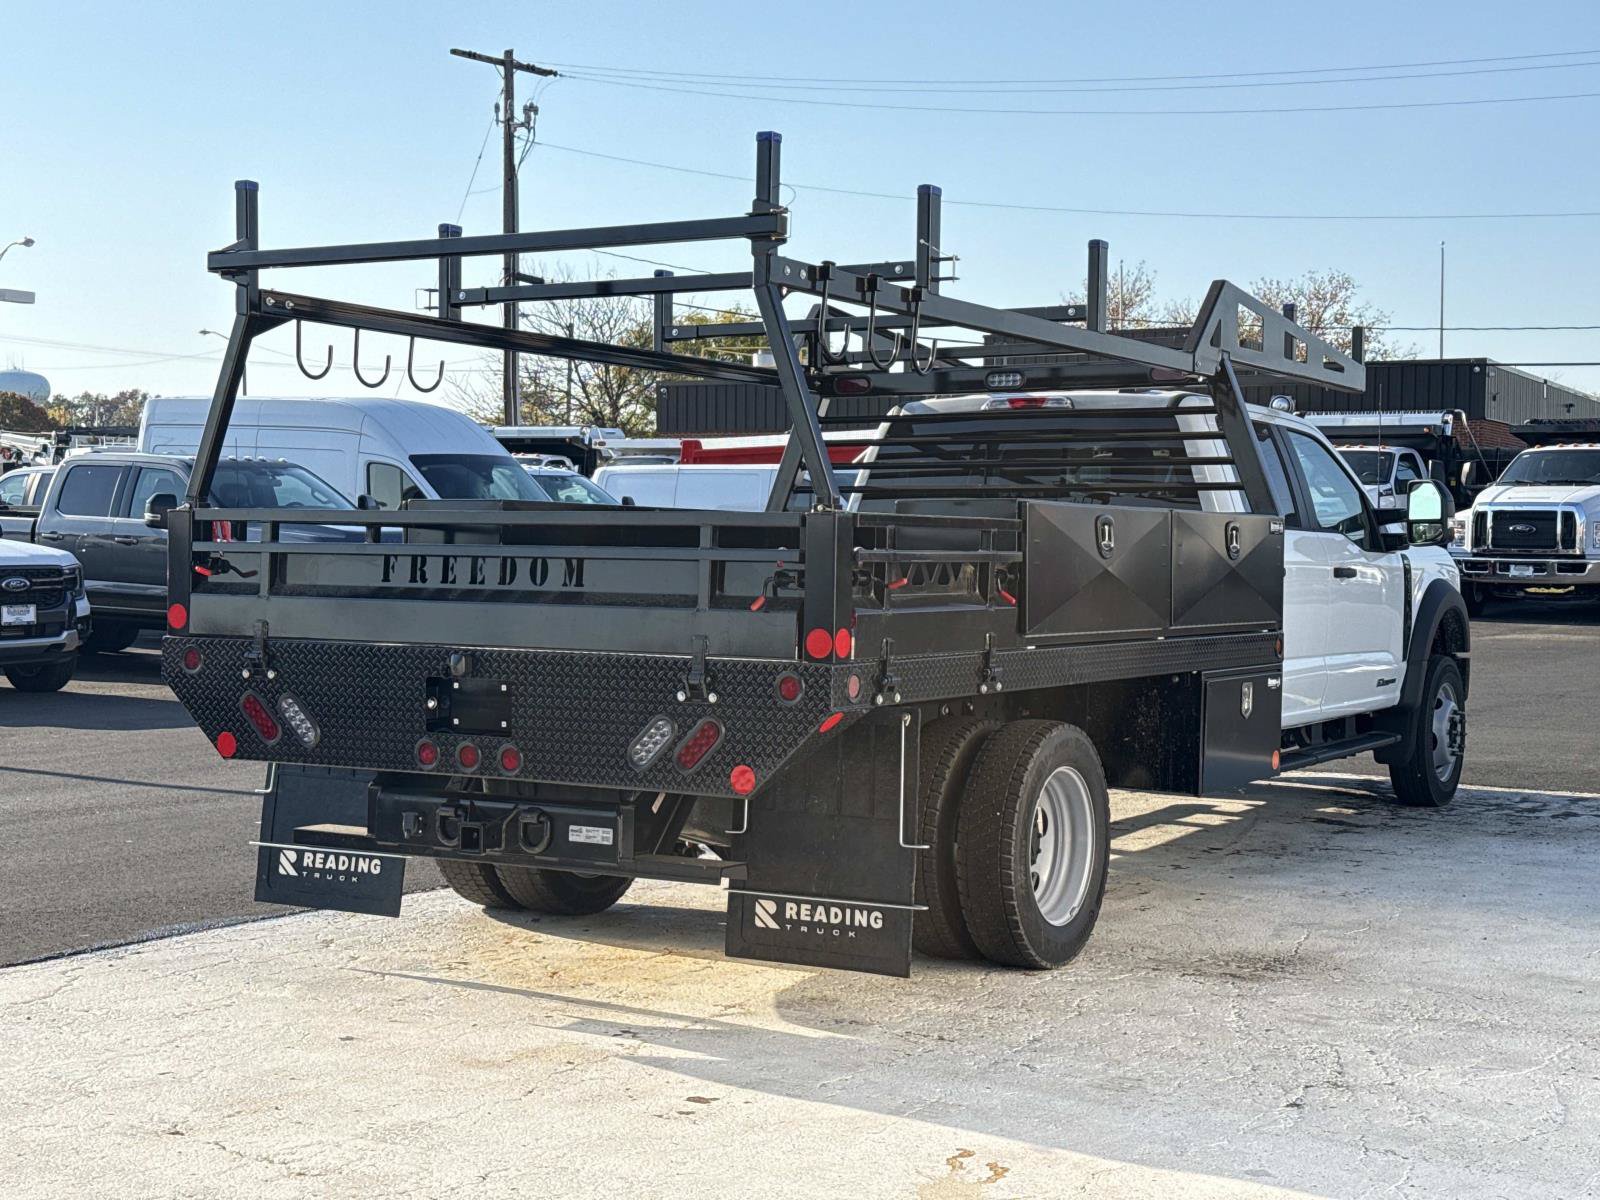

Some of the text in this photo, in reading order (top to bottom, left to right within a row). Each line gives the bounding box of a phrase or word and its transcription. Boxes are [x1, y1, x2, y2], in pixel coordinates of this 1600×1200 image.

[381, 554, 585, 588] FREEDOM
[303, 851, 382, 875] READING
[302, 871, 359, 883] TRUCK
[785, 901, 884, 929] READING
[785, 924, 857, 938] TRUCK
